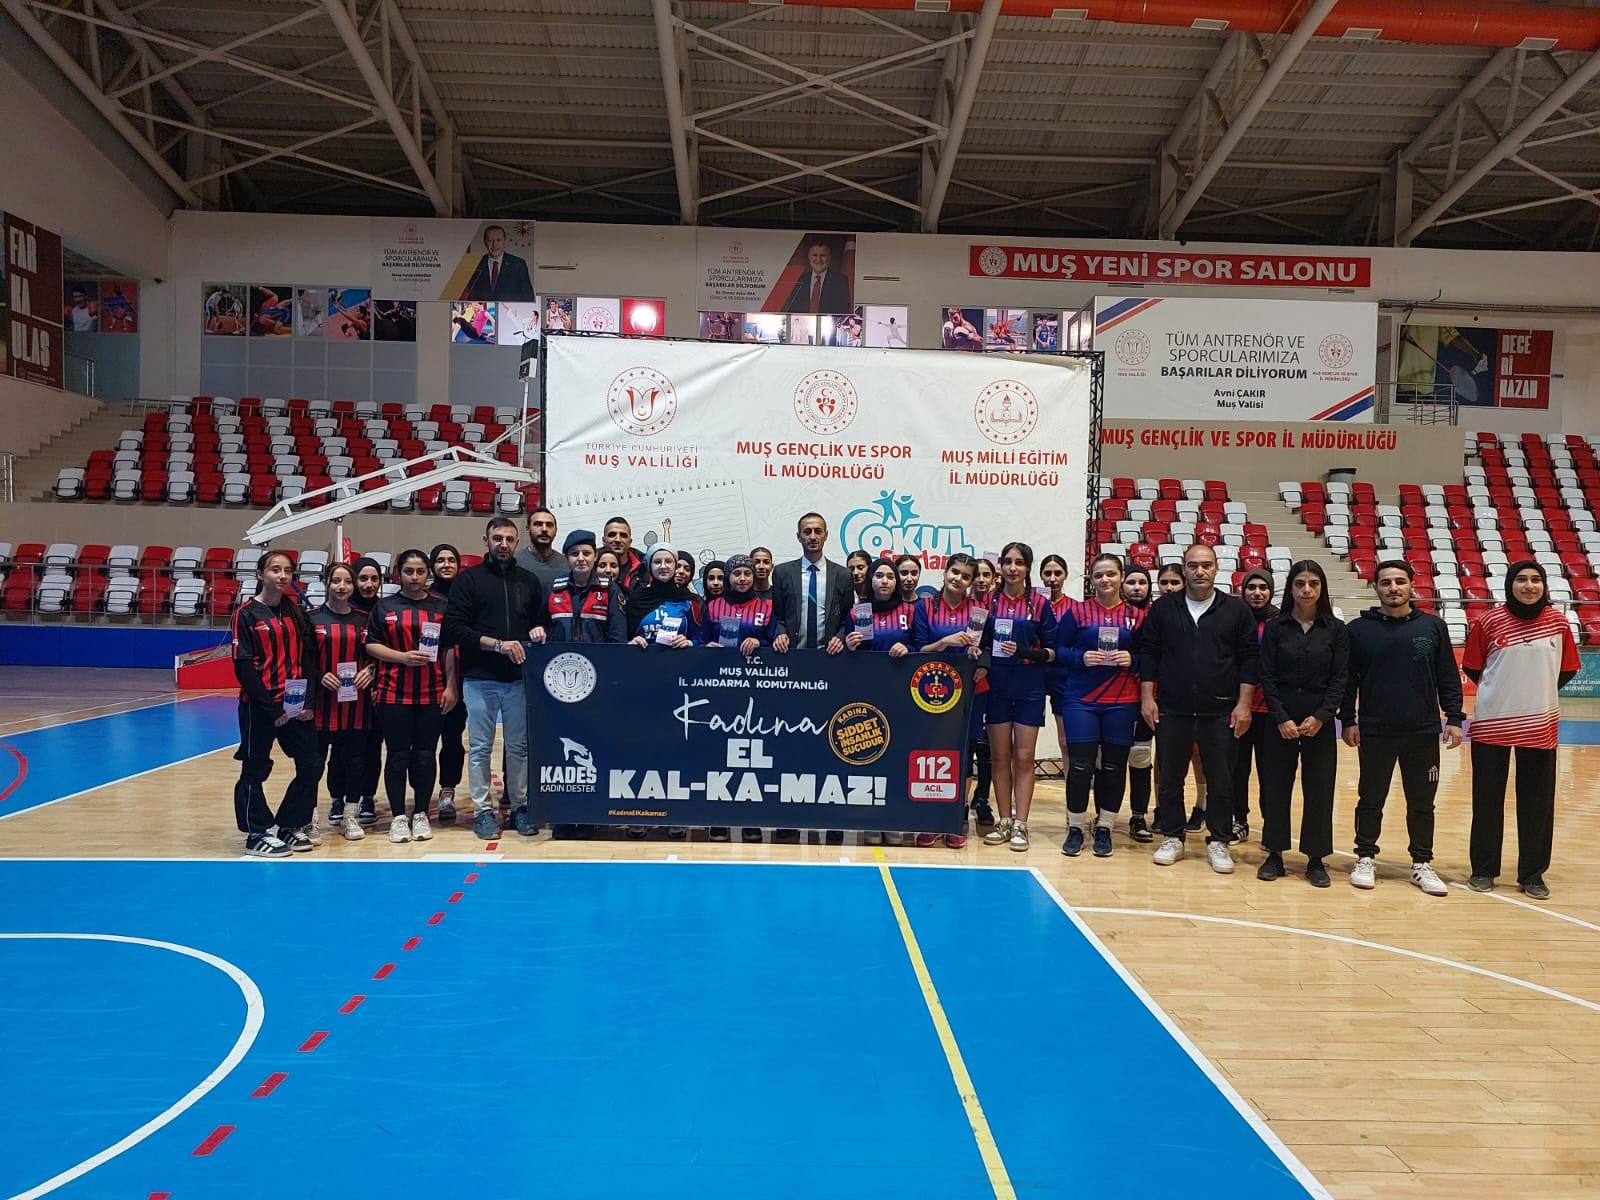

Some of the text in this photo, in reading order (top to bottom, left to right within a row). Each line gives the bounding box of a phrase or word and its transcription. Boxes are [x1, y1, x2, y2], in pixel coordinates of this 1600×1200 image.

[10, 226, 37, 274] FAR
[1013, 253, 1356, 282] MUŞ YENİ SPOR SALONU
[11, 319, 50, 371] ULAŞ
[1165, 331, 1305, 349] TÜM ANTRENÖR VE
[1170, 349, 1300, 364] SPORCULARIMIZA
[1161, 366, 1308, 380] BAŞARILAR DİLİYORUM
[1214, 389, 1266, 399] Avni ÇAKIR
[1217, 400, 1264, 410] Muş Valisi
[585, 442, 698, 454] TÜRKİYE CUMHURİYETİ
[1102, 427, 1397, 451] MUŞ GENÇLİK VE SPOR İL MÜDÜRLÜĞÜ
[737, 441, 912, 460] MUŞ GENÇLİK VE SPOR
[942, 449, 1068, 467] MUŞ MİLLİ EĞİTİM
[585, 454, 698, 469] MUŞ VALİLİĞİ
[764, 461, 885, 480] İL MÜDÜRLÜĞÜ
[950, 469, 1059, 487] İL MÜDÜRLÜĞÜ
[859, 522, 975, 558] OKUL
[754, 612, 765, 626] 2
[899, 614, 908, 630] 9
[746, 657, 764, 665] T.C.
[720, 667, 789, 678] MUŞ VALİLİĞİ
[678, 677, 828, 691] İL JANDARMA KOMUTANLIĞI
[673, 693, 829, 741] Kadına
[837, 708, 868, 724] KADINA
[727, 738, 774, 769] EL
[541, 766, 598, 784] KADES
[917, 756, 952, 780] 112
[541, 784, 596, 793] KADIN DESTEK
[609, 769, 888, 806] KAL-KA-MAZ!
[924, 784, 944, 793] ACİL
